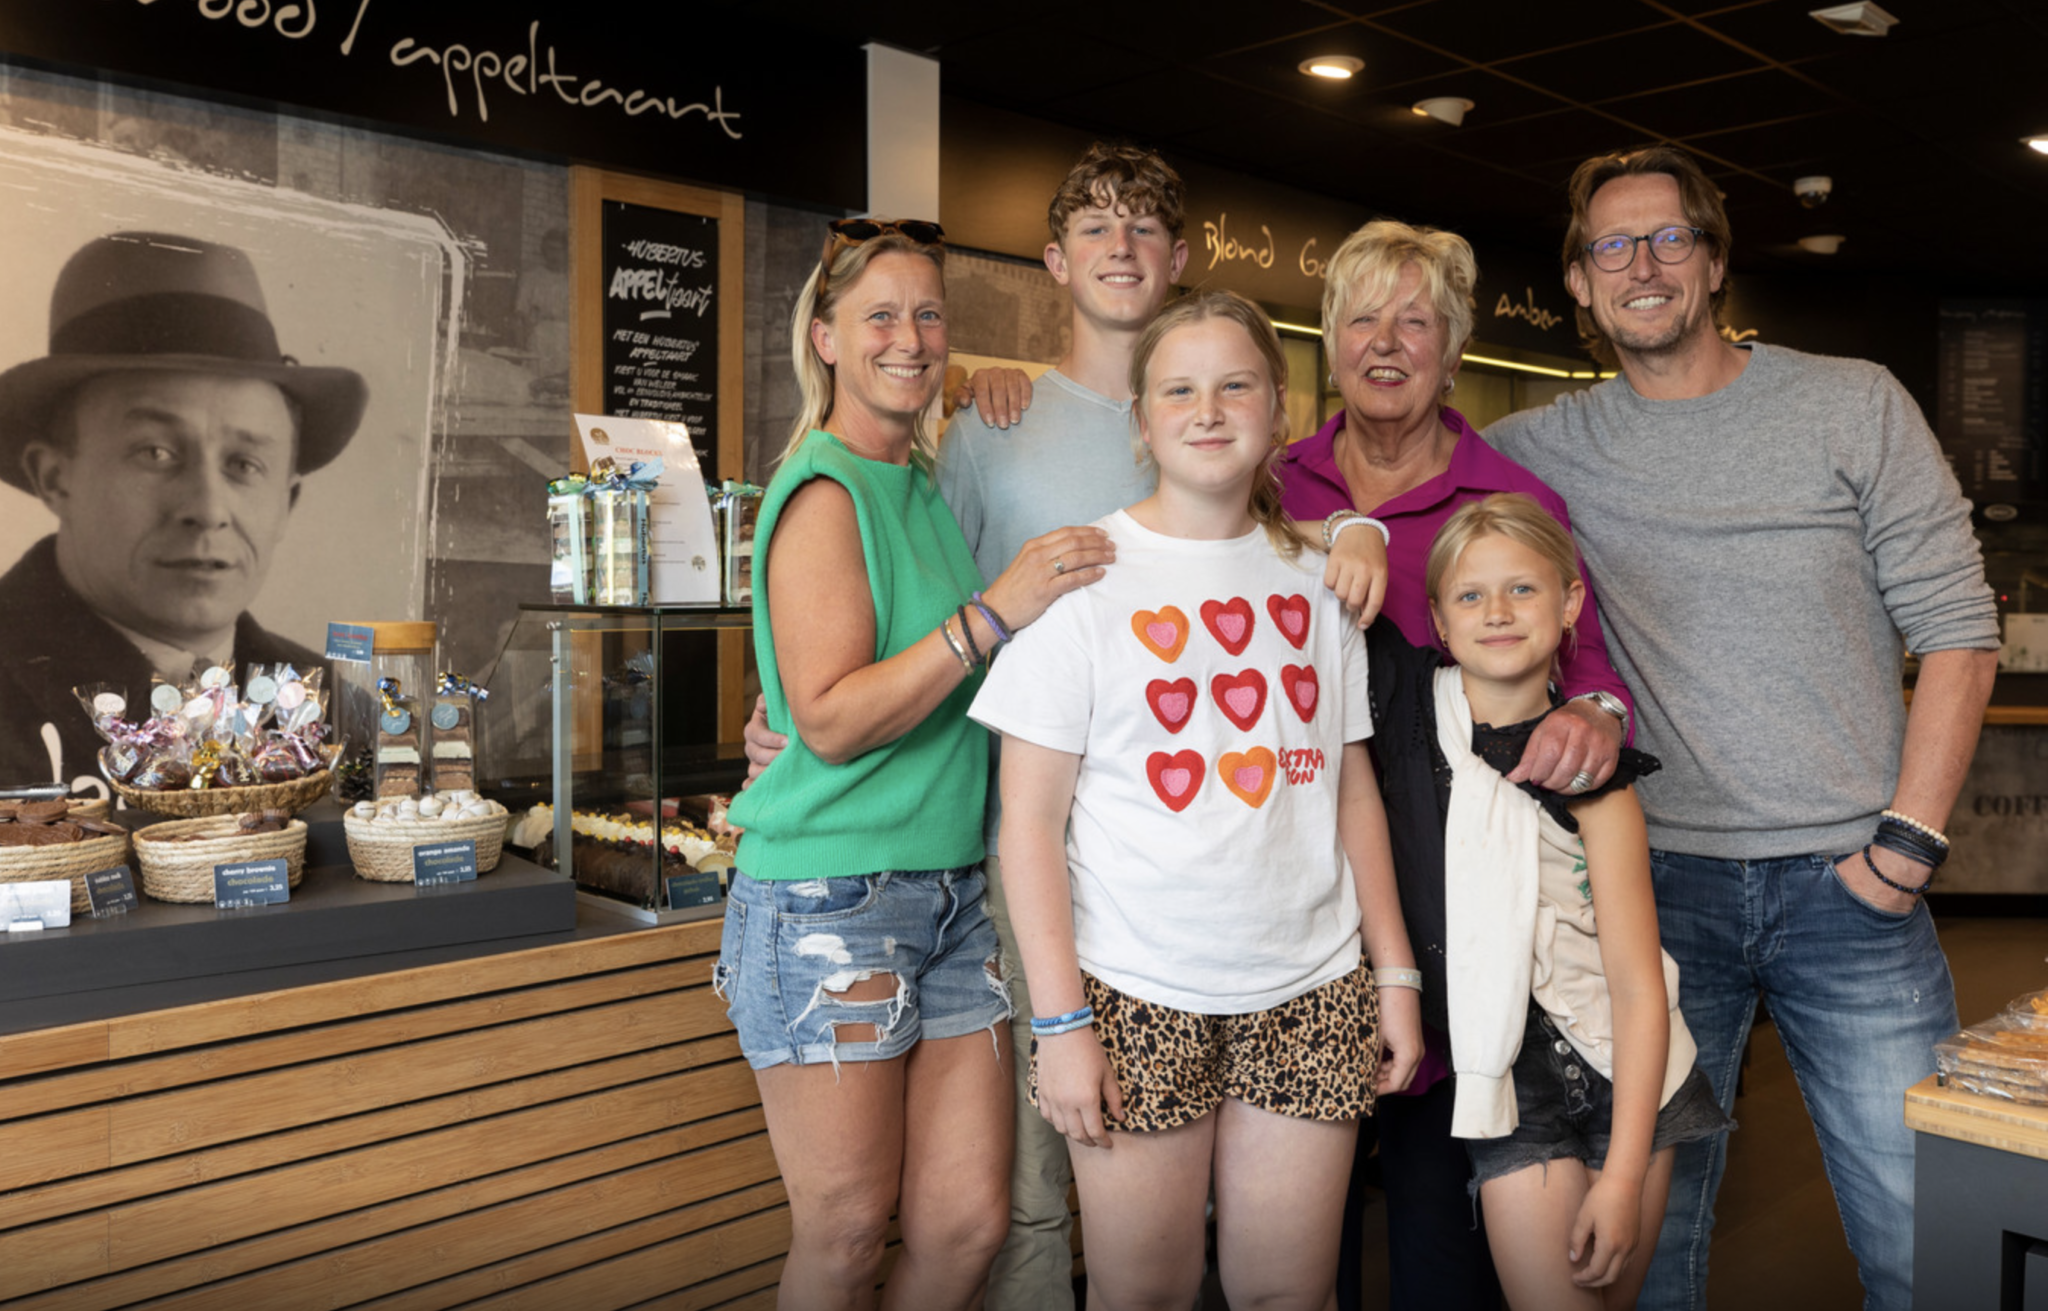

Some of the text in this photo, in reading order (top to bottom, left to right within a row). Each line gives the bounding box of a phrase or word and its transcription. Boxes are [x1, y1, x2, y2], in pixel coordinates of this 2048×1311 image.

[390, 20, 743, 140] appeltaart
[1203, 212, 1275, 271] Blond
[1494, 285, 1563, 332] Amber
[613, 329, 634, 341] MET
[632, 331, 651, 345] EEN
[629, 346, 694, 362] APPELTAART
[614, 365, 636, 376] KIEST
[643, 368, 661, 378] VOOR
[661, 369, 671, 380] DE
[614, 446, 634, 454] CHOC
[1278, 745, 1325, 771] EXTRA
[424, 854, 464, 867] chocolade
[222, 865, 276, 876] cherry brownie
[227, 875, 274, 887] chocolade
